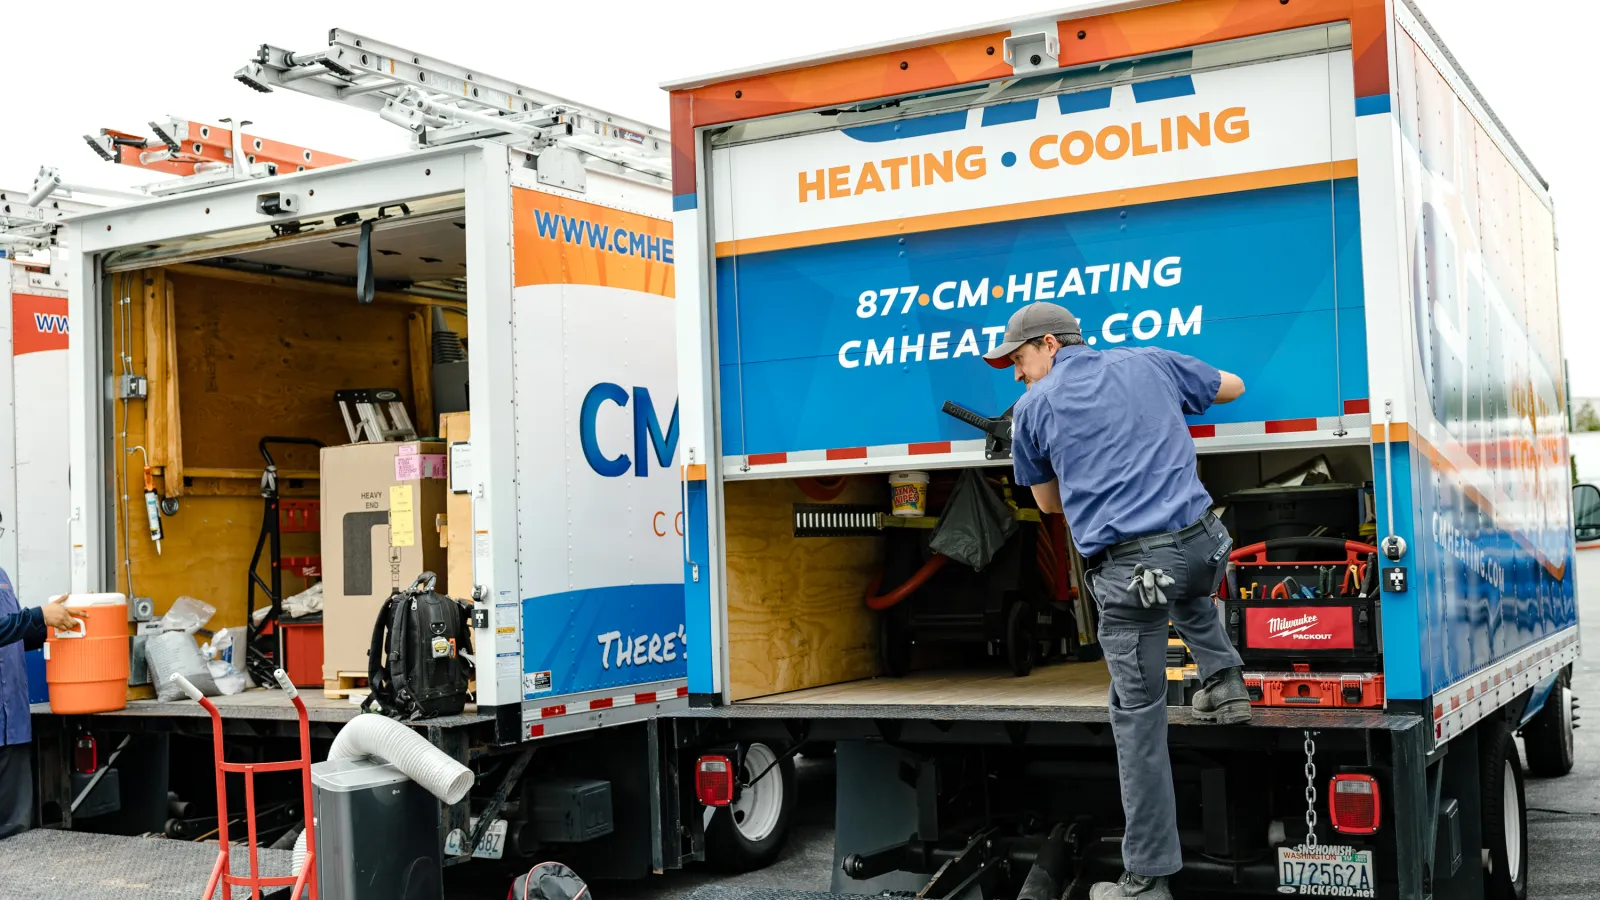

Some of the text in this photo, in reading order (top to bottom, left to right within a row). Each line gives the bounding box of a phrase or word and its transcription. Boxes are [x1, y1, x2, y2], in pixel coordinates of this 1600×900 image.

[798, 106, 1250, 203] HEATING COOLING
[579, 382, 680, 477] CM
[365, 501, 379, 509] END
[1432, 511, 1505, 593] CMHEATING.COM
[1267, 614, 1318, 633] Milwaukee
[1283, 861, 1370, 889] D72562A
[1299, 884, 1375, 898] BICKFORD.net
